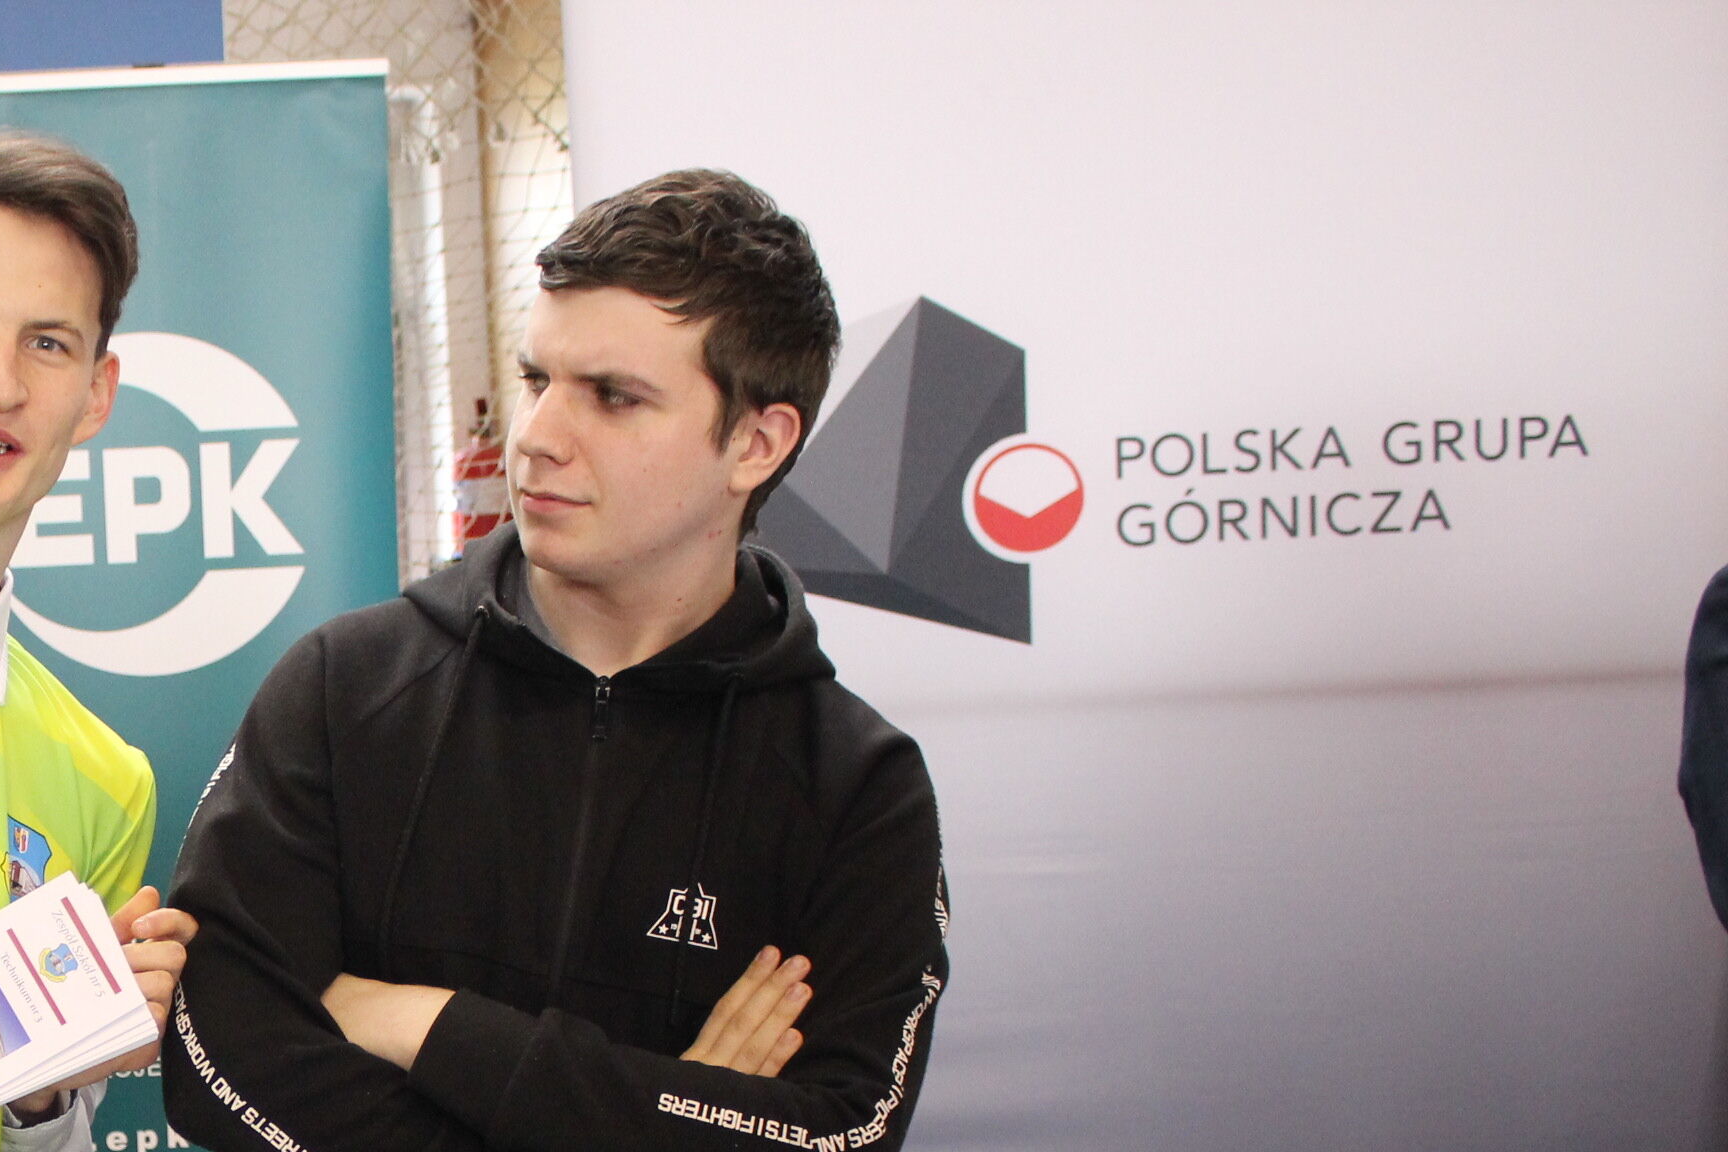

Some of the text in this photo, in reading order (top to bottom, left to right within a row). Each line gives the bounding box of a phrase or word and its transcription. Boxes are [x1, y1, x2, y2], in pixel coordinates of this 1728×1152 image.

[1116, 414, 1589, 479] POLSKA GRUPA
[11, 439, 305, 568] EPK
[1116, 488, 1452, 547] GÓRNICZA
[211, 1076, 248, 1112] AND
[657, 1092, 755, 1134] FIGHTERS
